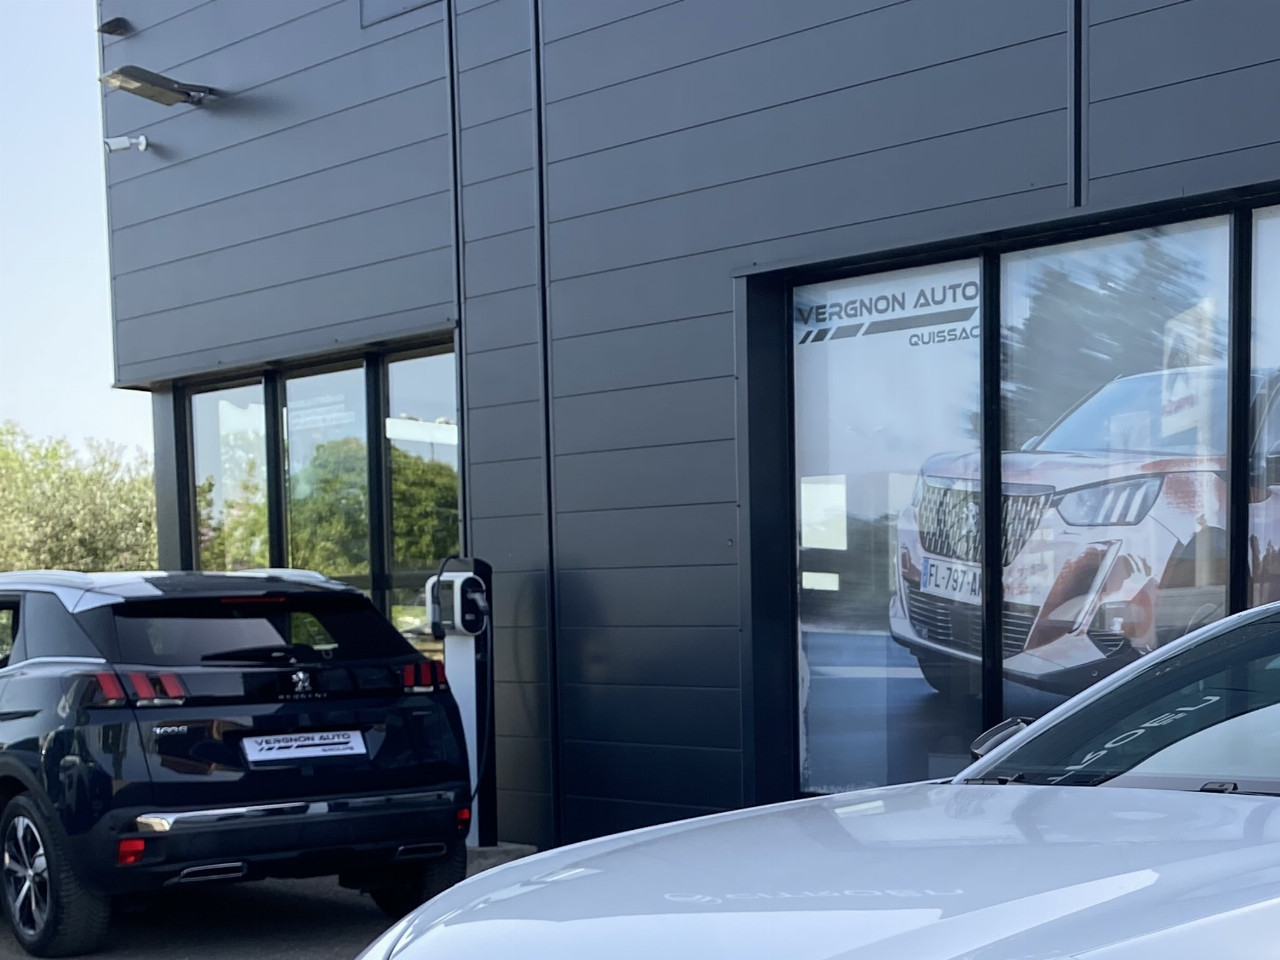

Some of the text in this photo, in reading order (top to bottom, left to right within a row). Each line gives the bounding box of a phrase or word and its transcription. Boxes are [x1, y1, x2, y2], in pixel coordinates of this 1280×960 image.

[799, 280, 979, 326] VERGNON AUTO
[909, 325, 980, 347] QUISSAC
[318, 732, 351, 743] AUTO
